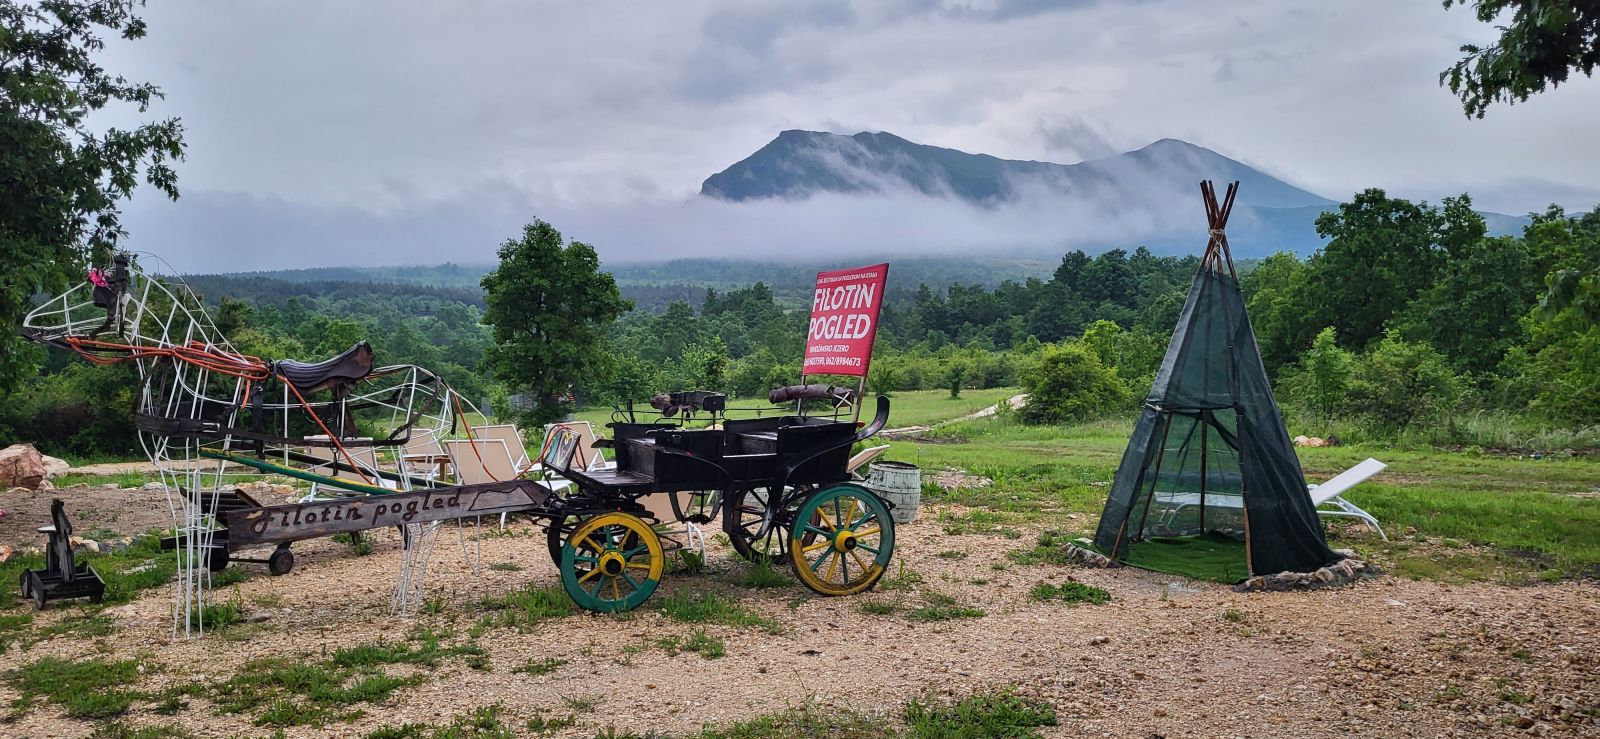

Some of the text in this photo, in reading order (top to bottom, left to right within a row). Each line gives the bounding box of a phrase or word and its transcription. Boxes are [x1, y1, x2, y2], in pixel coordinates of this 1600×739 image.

[812, 283, 875, 312] FILOTIN
[808, 314, 871, 341] POGLED
[250, 487, 461, 534] Filotin pogled
